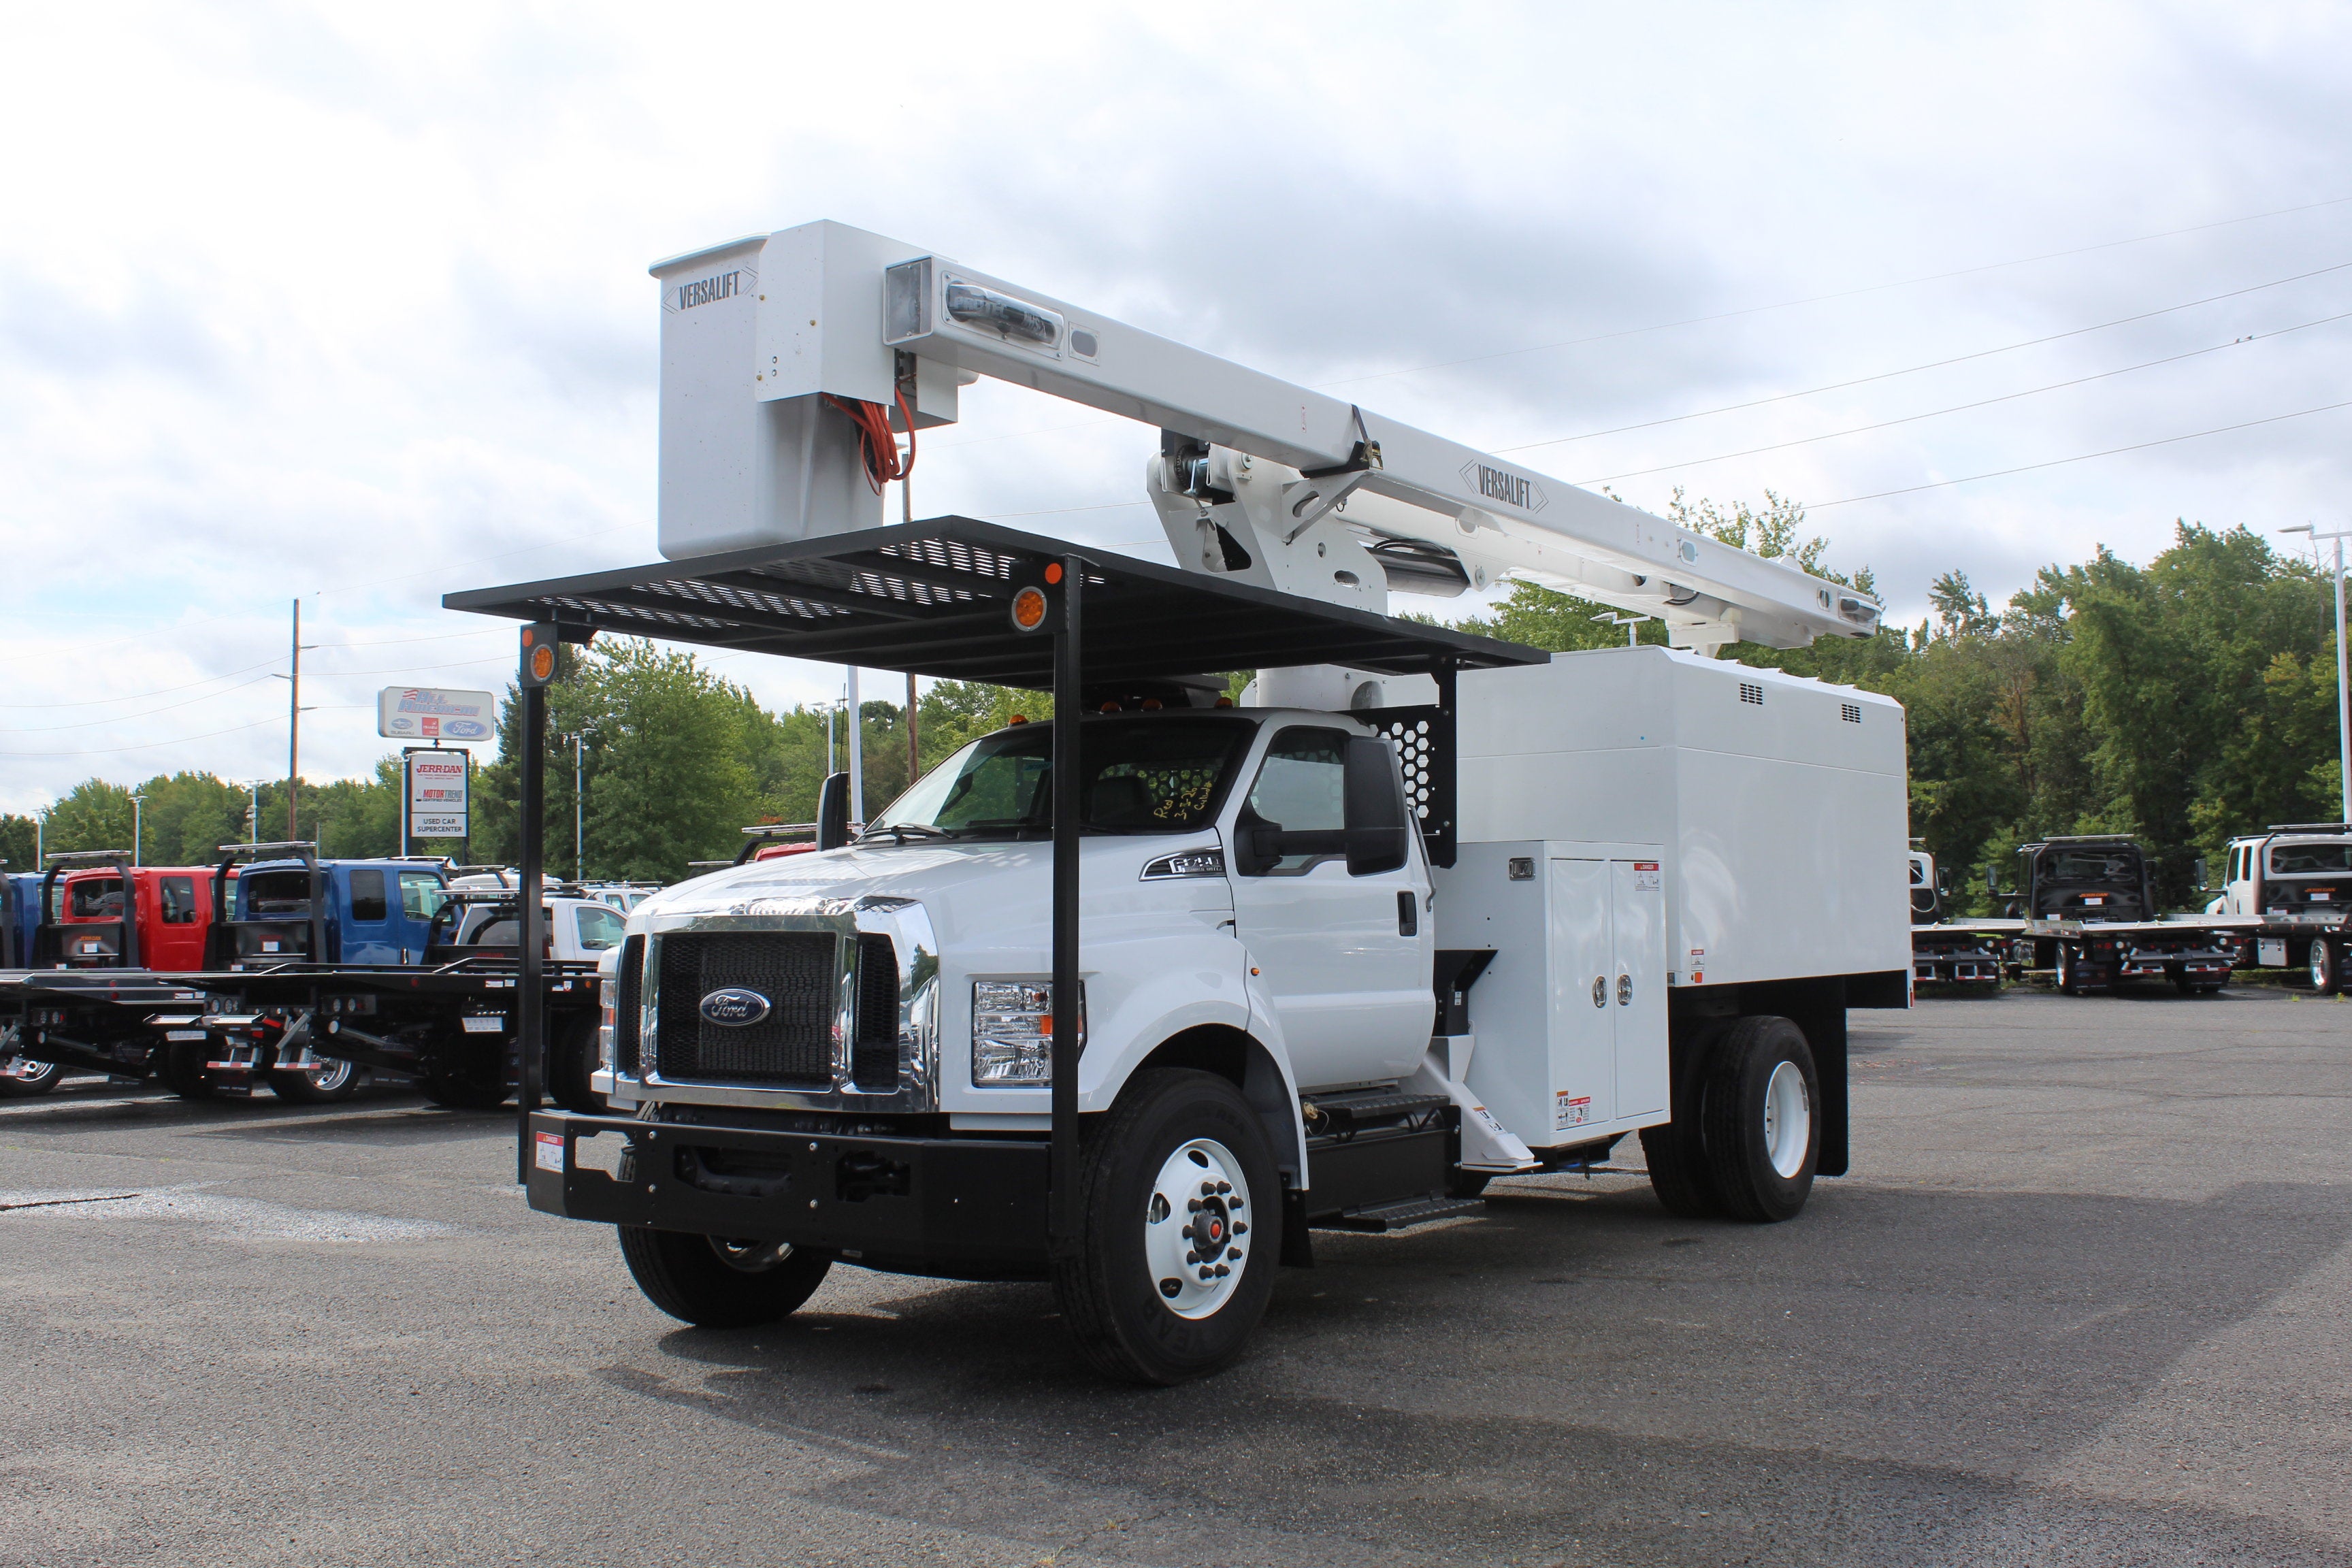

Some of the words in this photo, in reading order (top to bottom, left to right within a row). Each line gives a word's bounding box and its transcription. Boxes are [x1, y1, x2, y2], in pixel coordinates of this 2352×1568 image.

[679, 271, 740, 310] VERSALIFT
[1478, 464, 1530, 509] VERSALIFT
[453, 721, 478, 734] Ford
[711, 994, 749, 1017] Ford
